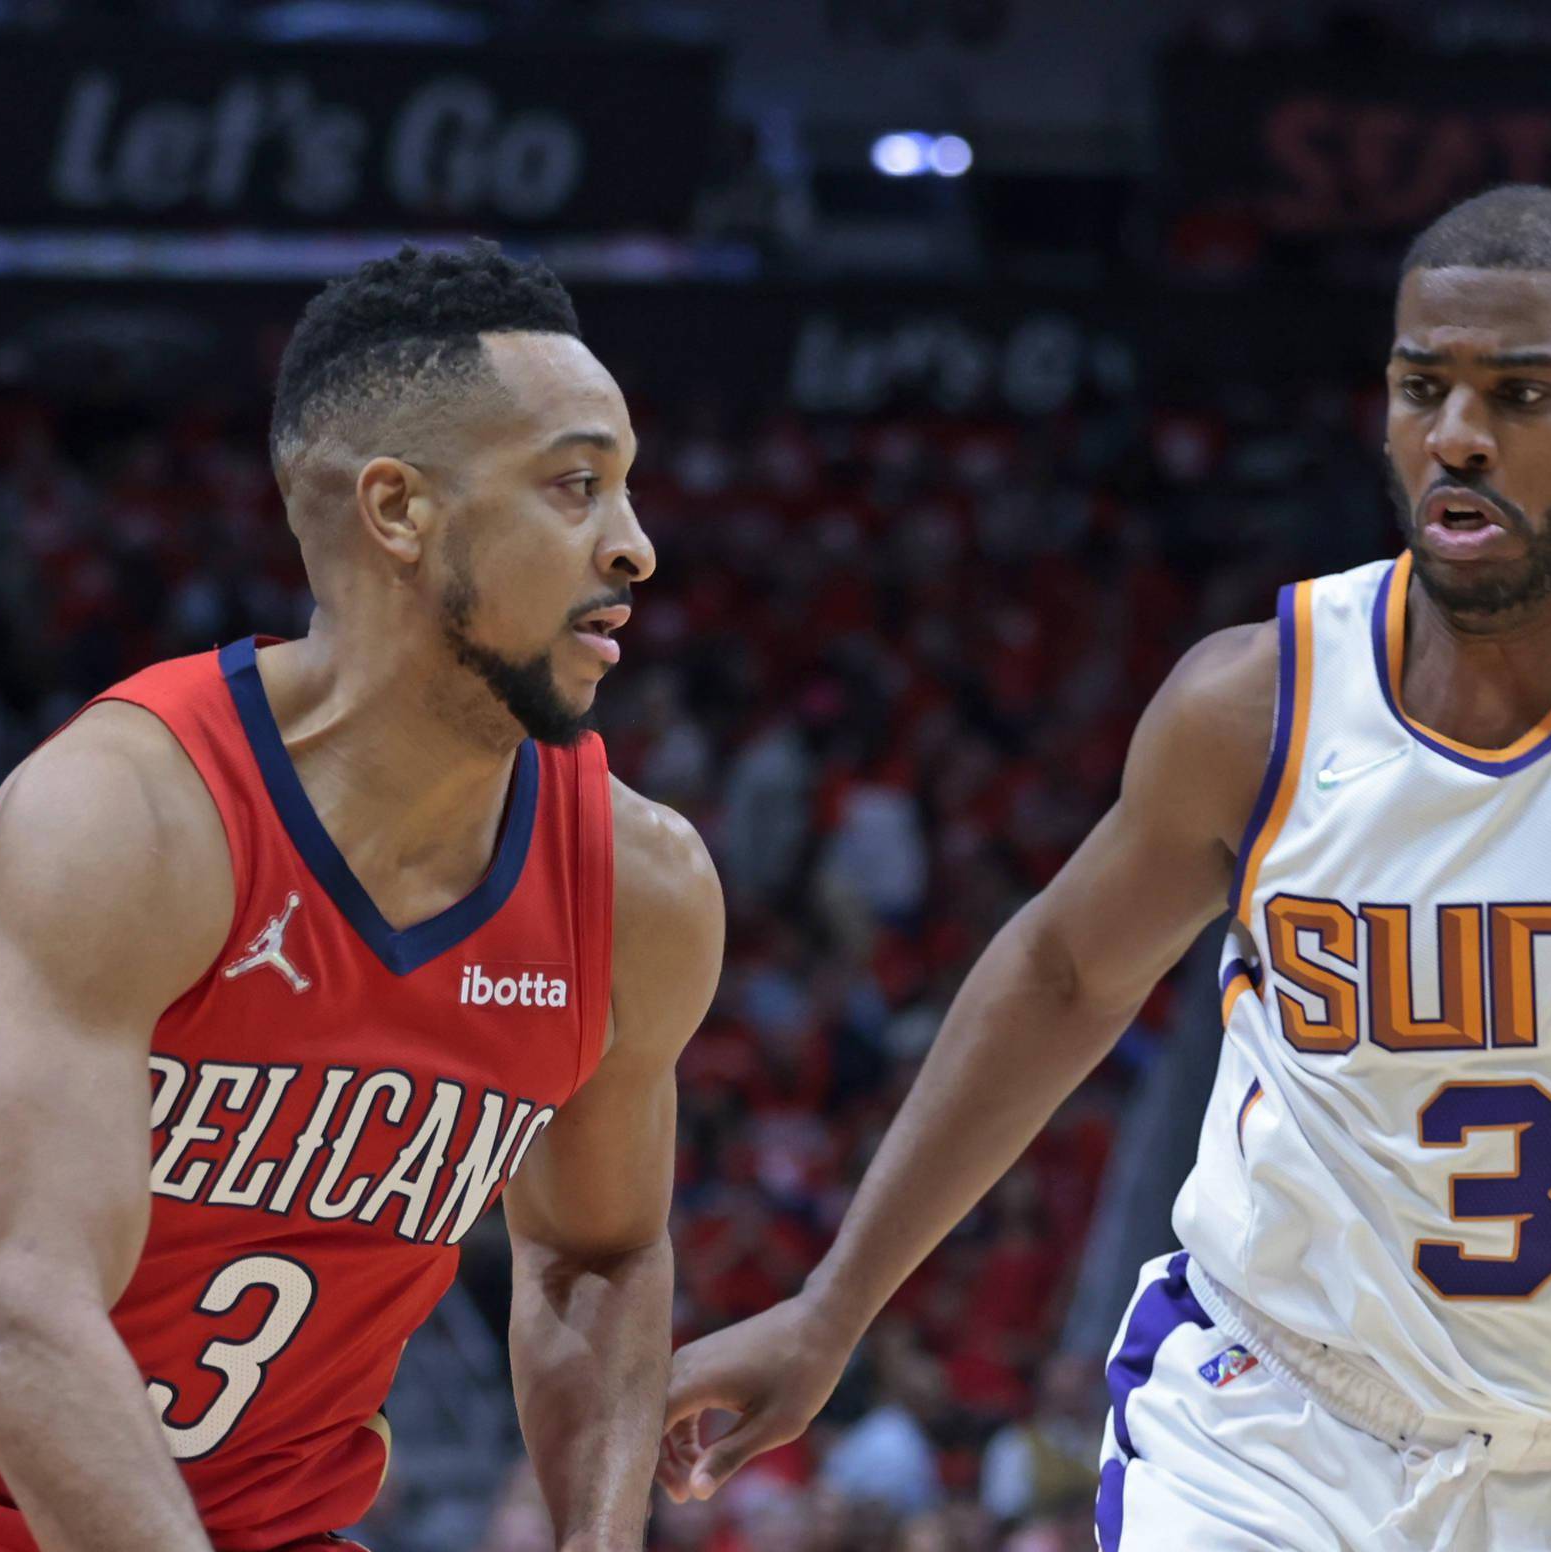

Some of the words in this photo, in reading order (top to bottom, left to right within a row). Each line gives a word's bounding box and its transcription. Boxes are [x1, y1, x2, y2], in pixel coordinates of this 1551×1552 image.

[53, 68, 370, 212] Let's
[387, 72, 586, 220] Go
[459, 964, 568, 1008] ibotta
[149, 1252, 319, 1464] 3
